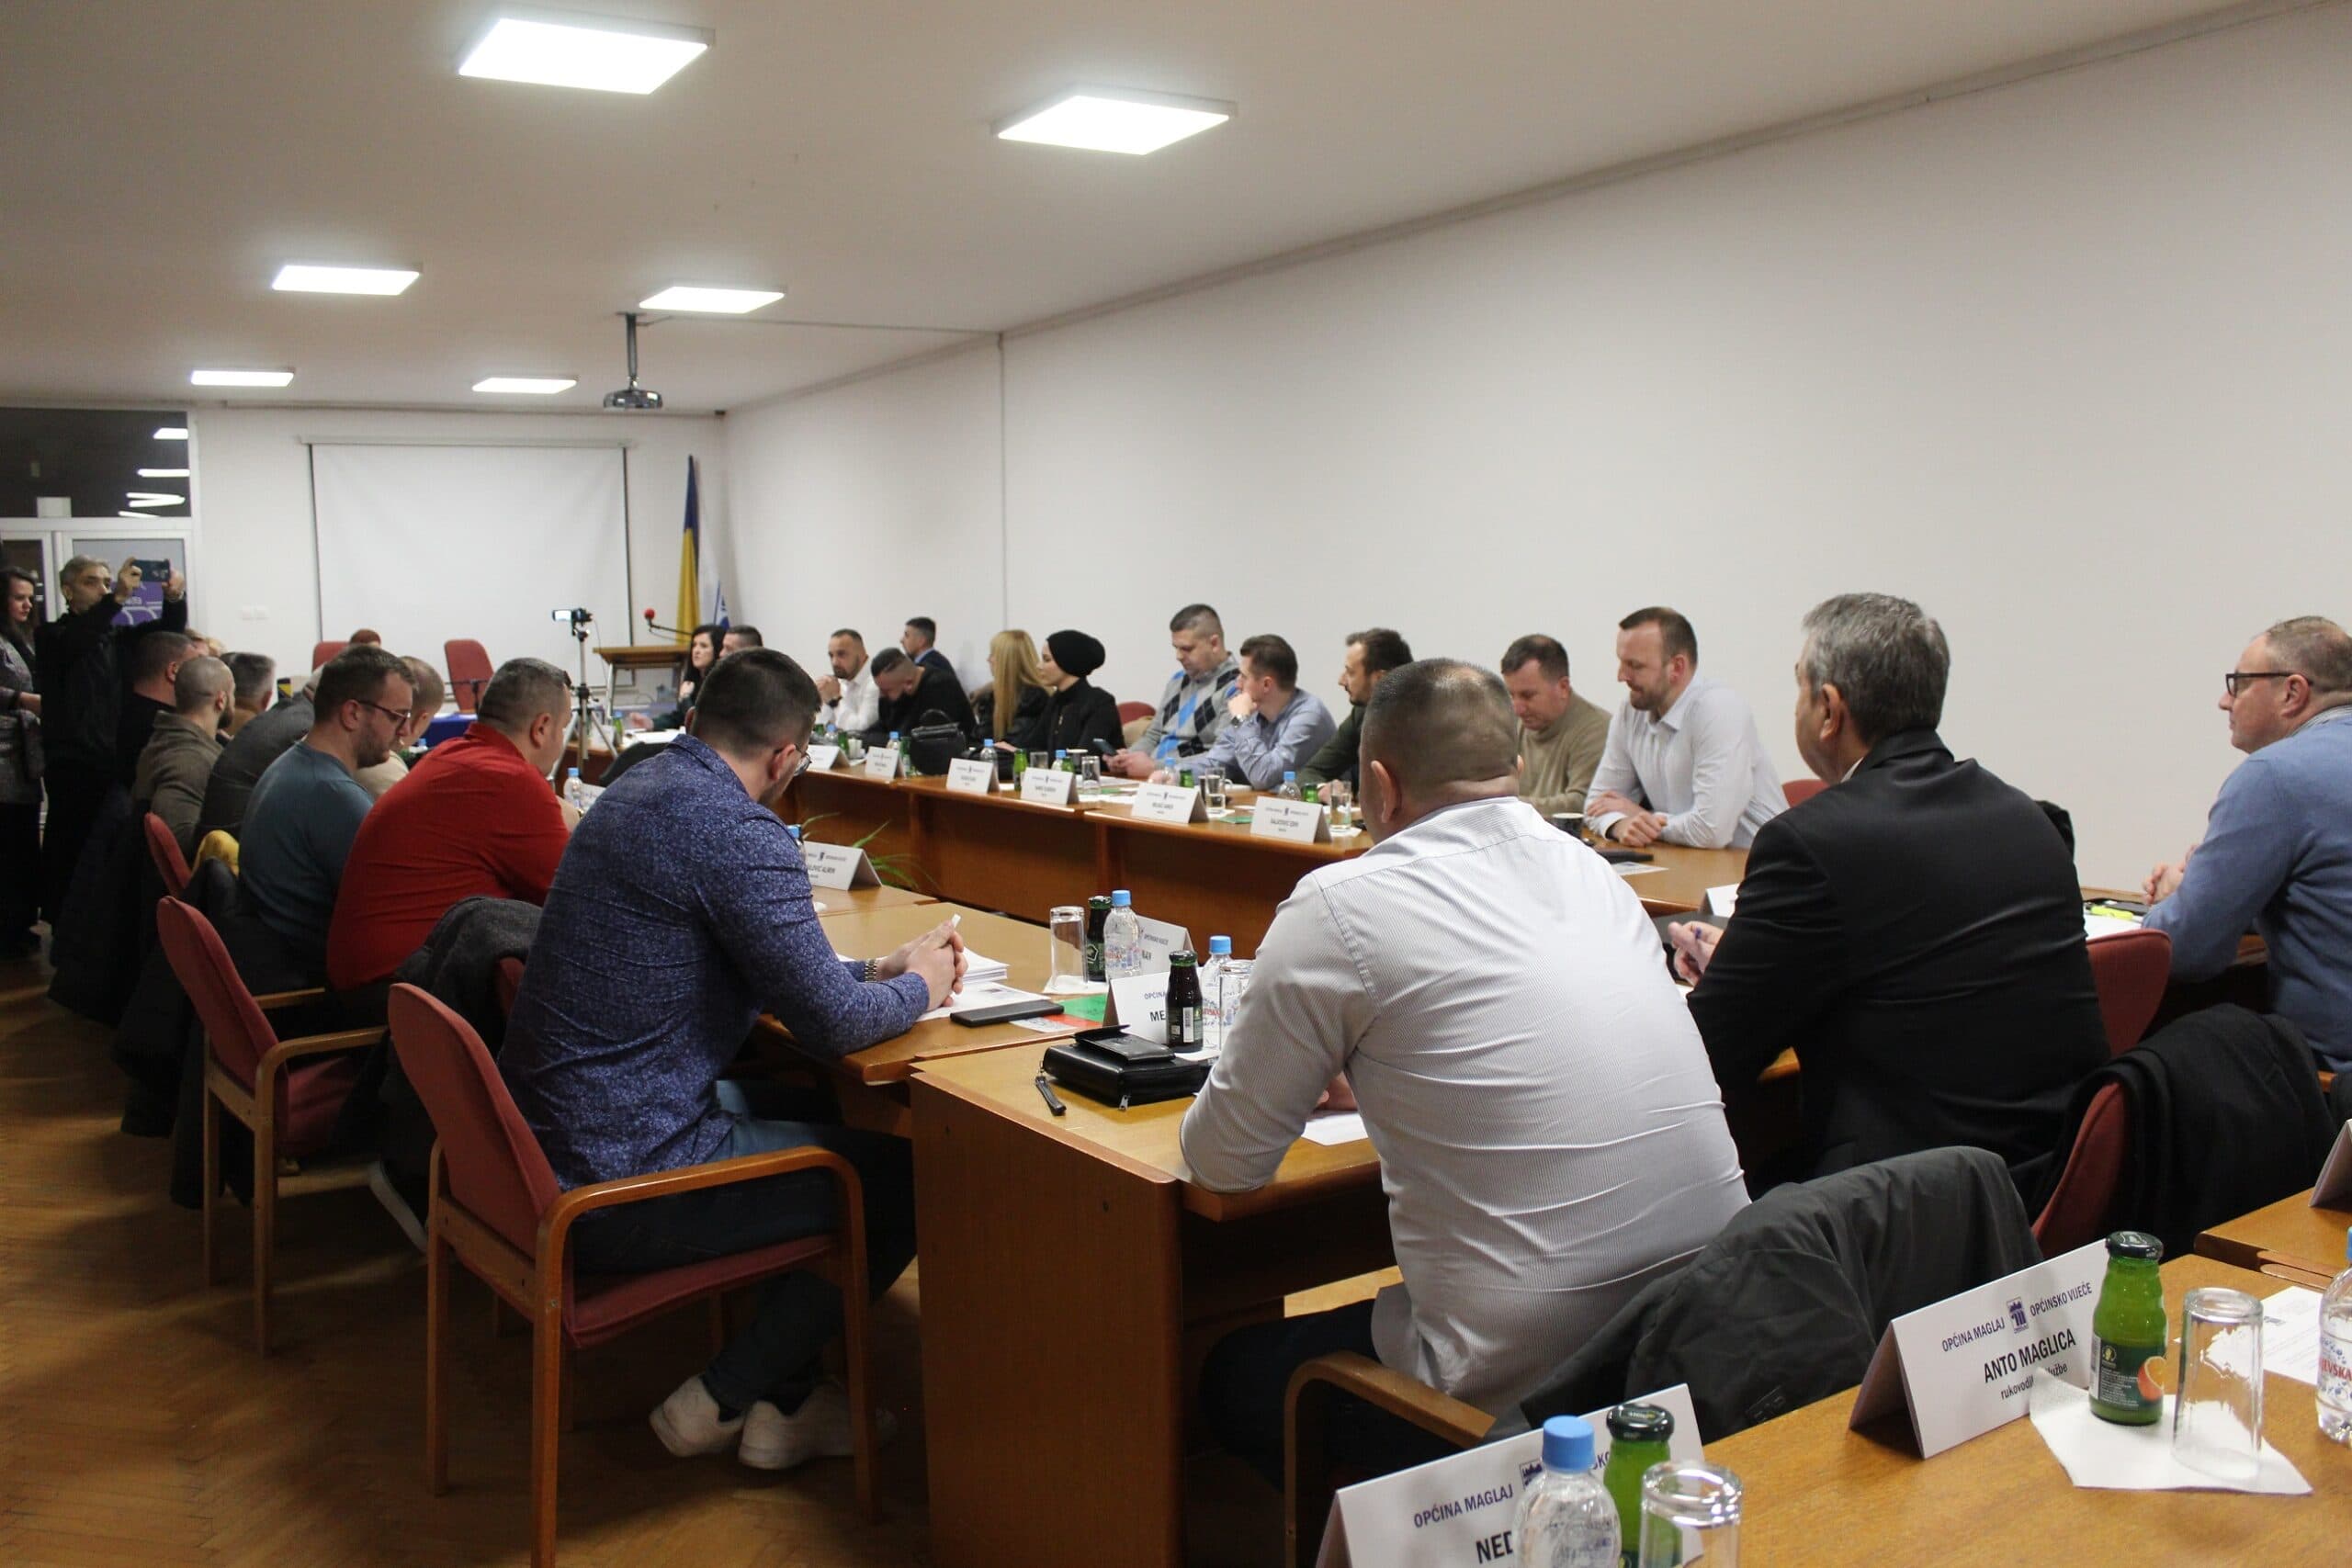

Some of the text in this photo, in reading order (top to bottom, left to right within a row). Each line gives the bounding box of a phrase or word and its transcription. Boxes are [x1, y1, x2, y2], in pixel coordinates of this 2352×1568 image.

[1941, 1331, 1973, 1352] OPĆINA
[1973, 1316, 2005, 1340] MAGLAJ
[2030, 1292, 2067, 1316] OPĆINSKO
[1984, 1328, 2076, 1383] ANTO MAGLICA
[1414, 1483, 1514, 1528] OPĆINA MAGLAJ
